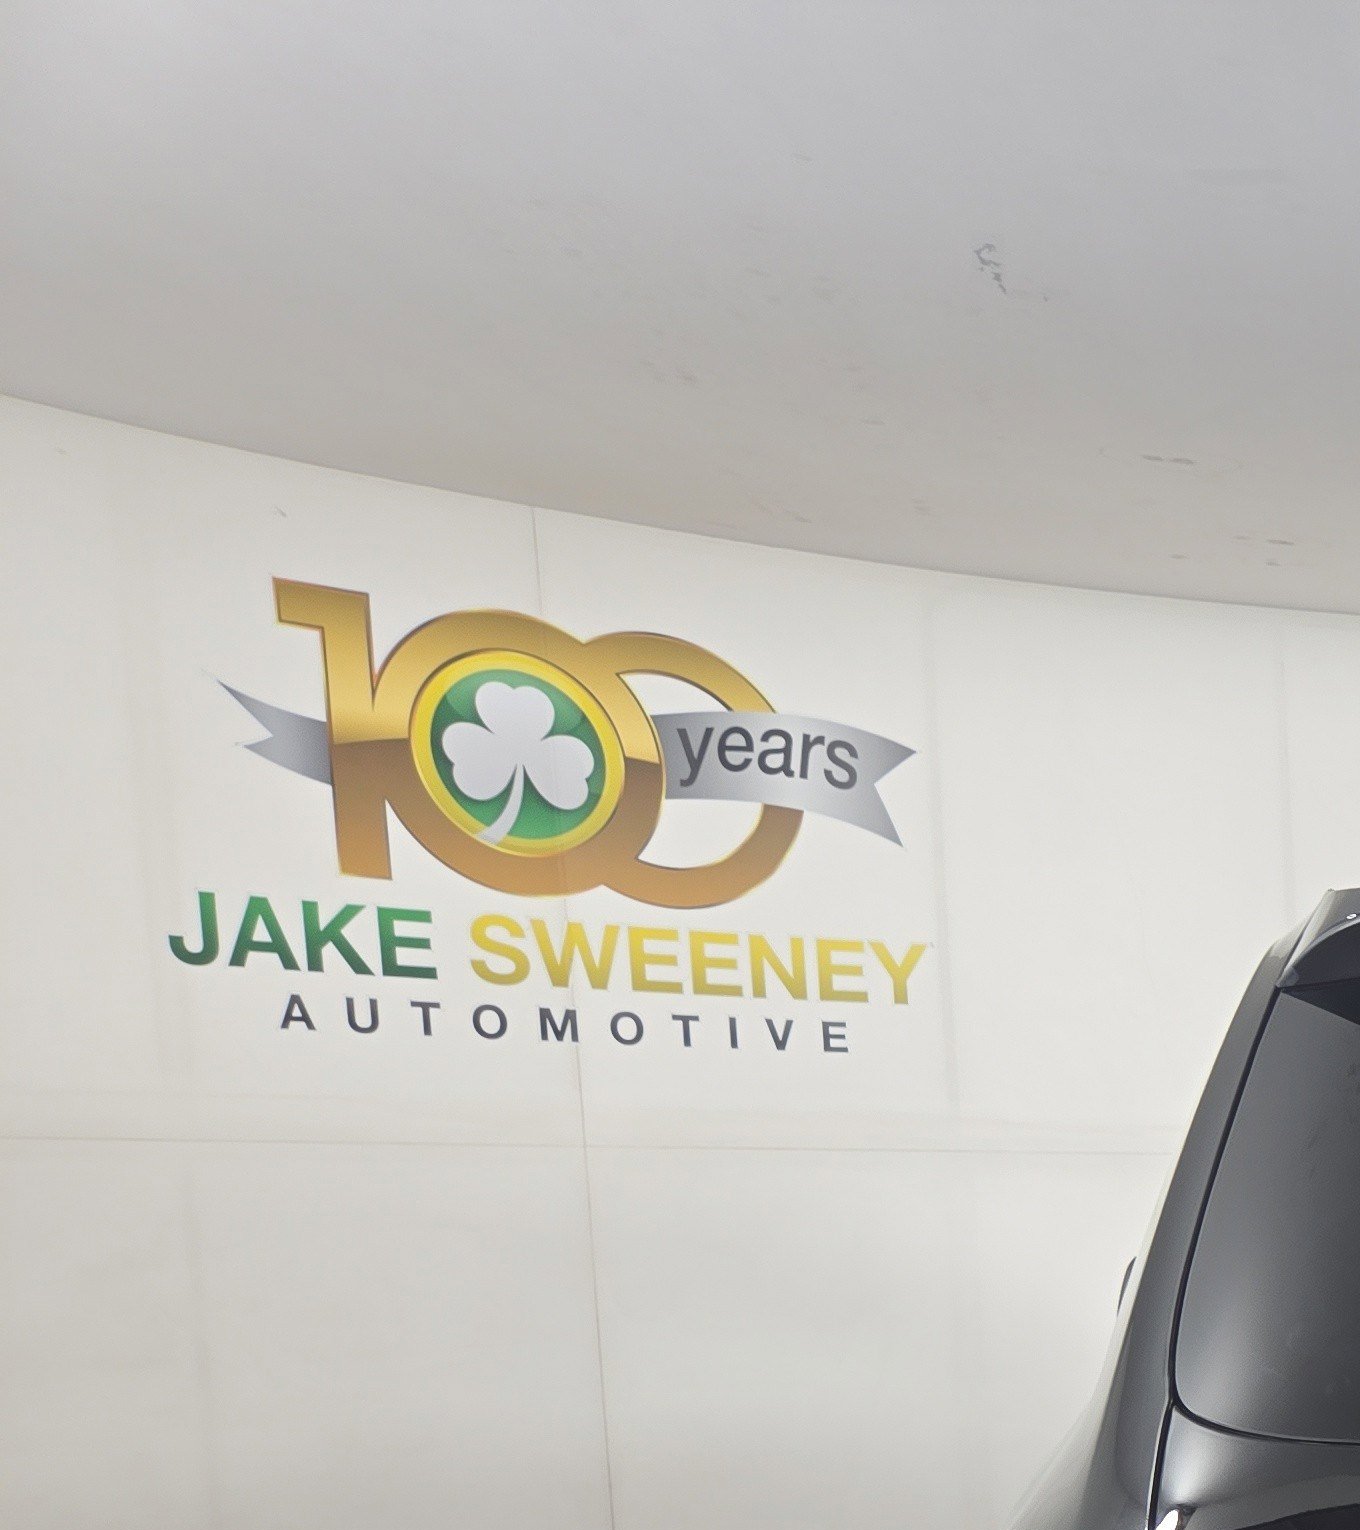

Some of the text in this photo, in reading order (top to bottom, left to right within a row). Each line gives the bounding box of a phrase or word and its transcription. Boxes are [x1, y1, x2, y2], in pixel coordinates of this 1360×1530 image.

[272, 576, 803, 908] 100
[677, 724, 859, 790] years
[168, 890, 926, 1005] JAKE SWEENEY
[281, 994, 850, 1053] AUTOMOTIVE
